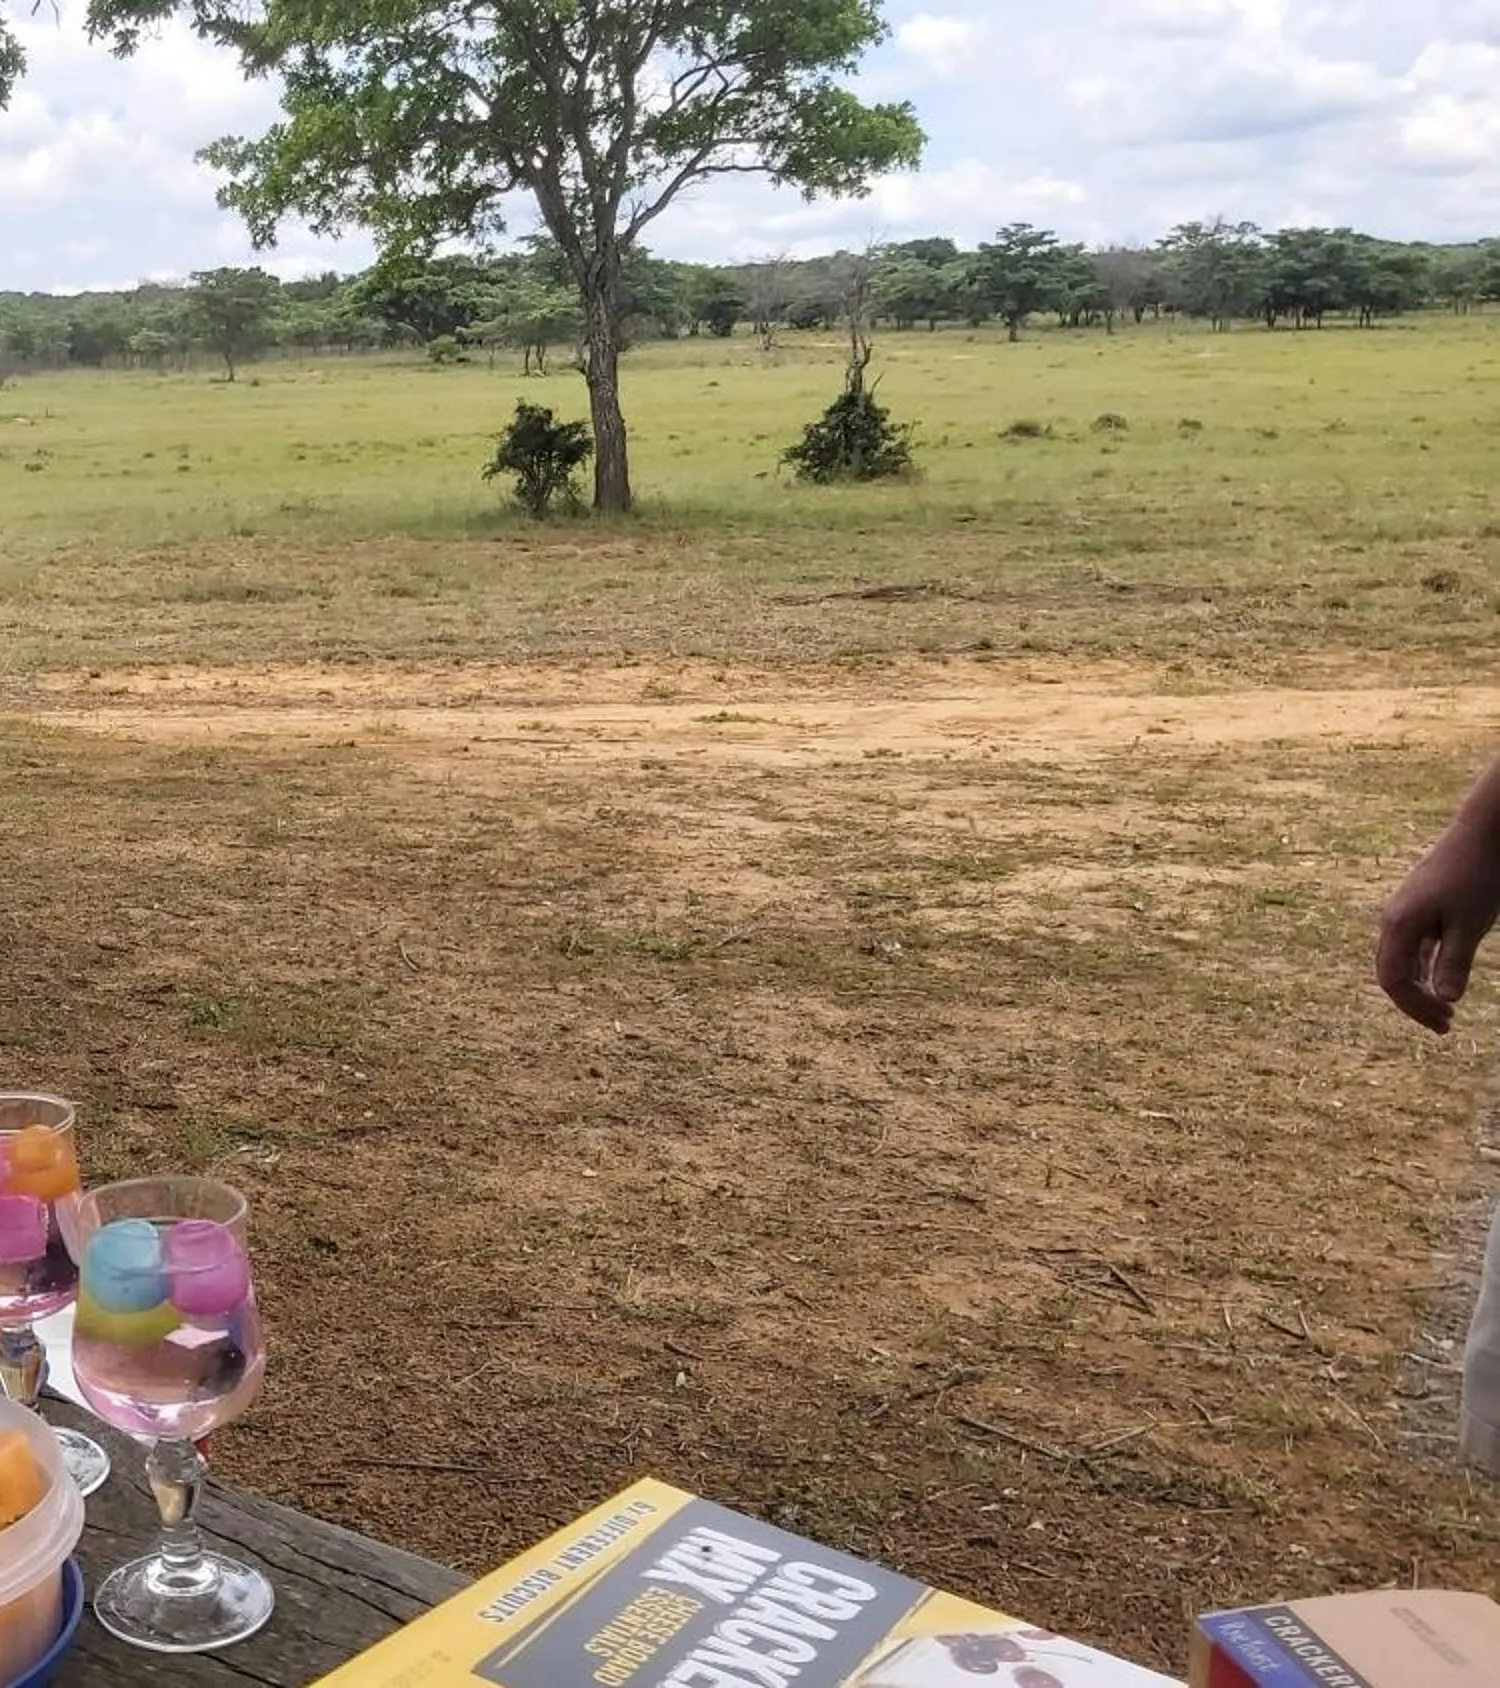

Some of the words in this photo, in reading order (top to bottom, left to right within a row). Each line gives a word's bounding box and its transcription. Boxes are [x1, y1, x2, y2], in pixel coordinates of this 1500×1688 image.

[553, 1514, 640, 1571] DIFFERENT
[640, 1526, 783, 1604] MIX
[478, 1568, 562, 1623] BISCUITS
[583, 1585, 677, 1657] ESSENTIALS
[637, 1595, 705, 1646] CHEESE
[656, 1561, 878, 1688] CRACKE
[592, 1638, 658, 1687] BOARD
[1264, 1615, 1361, 1688] CRACKER
